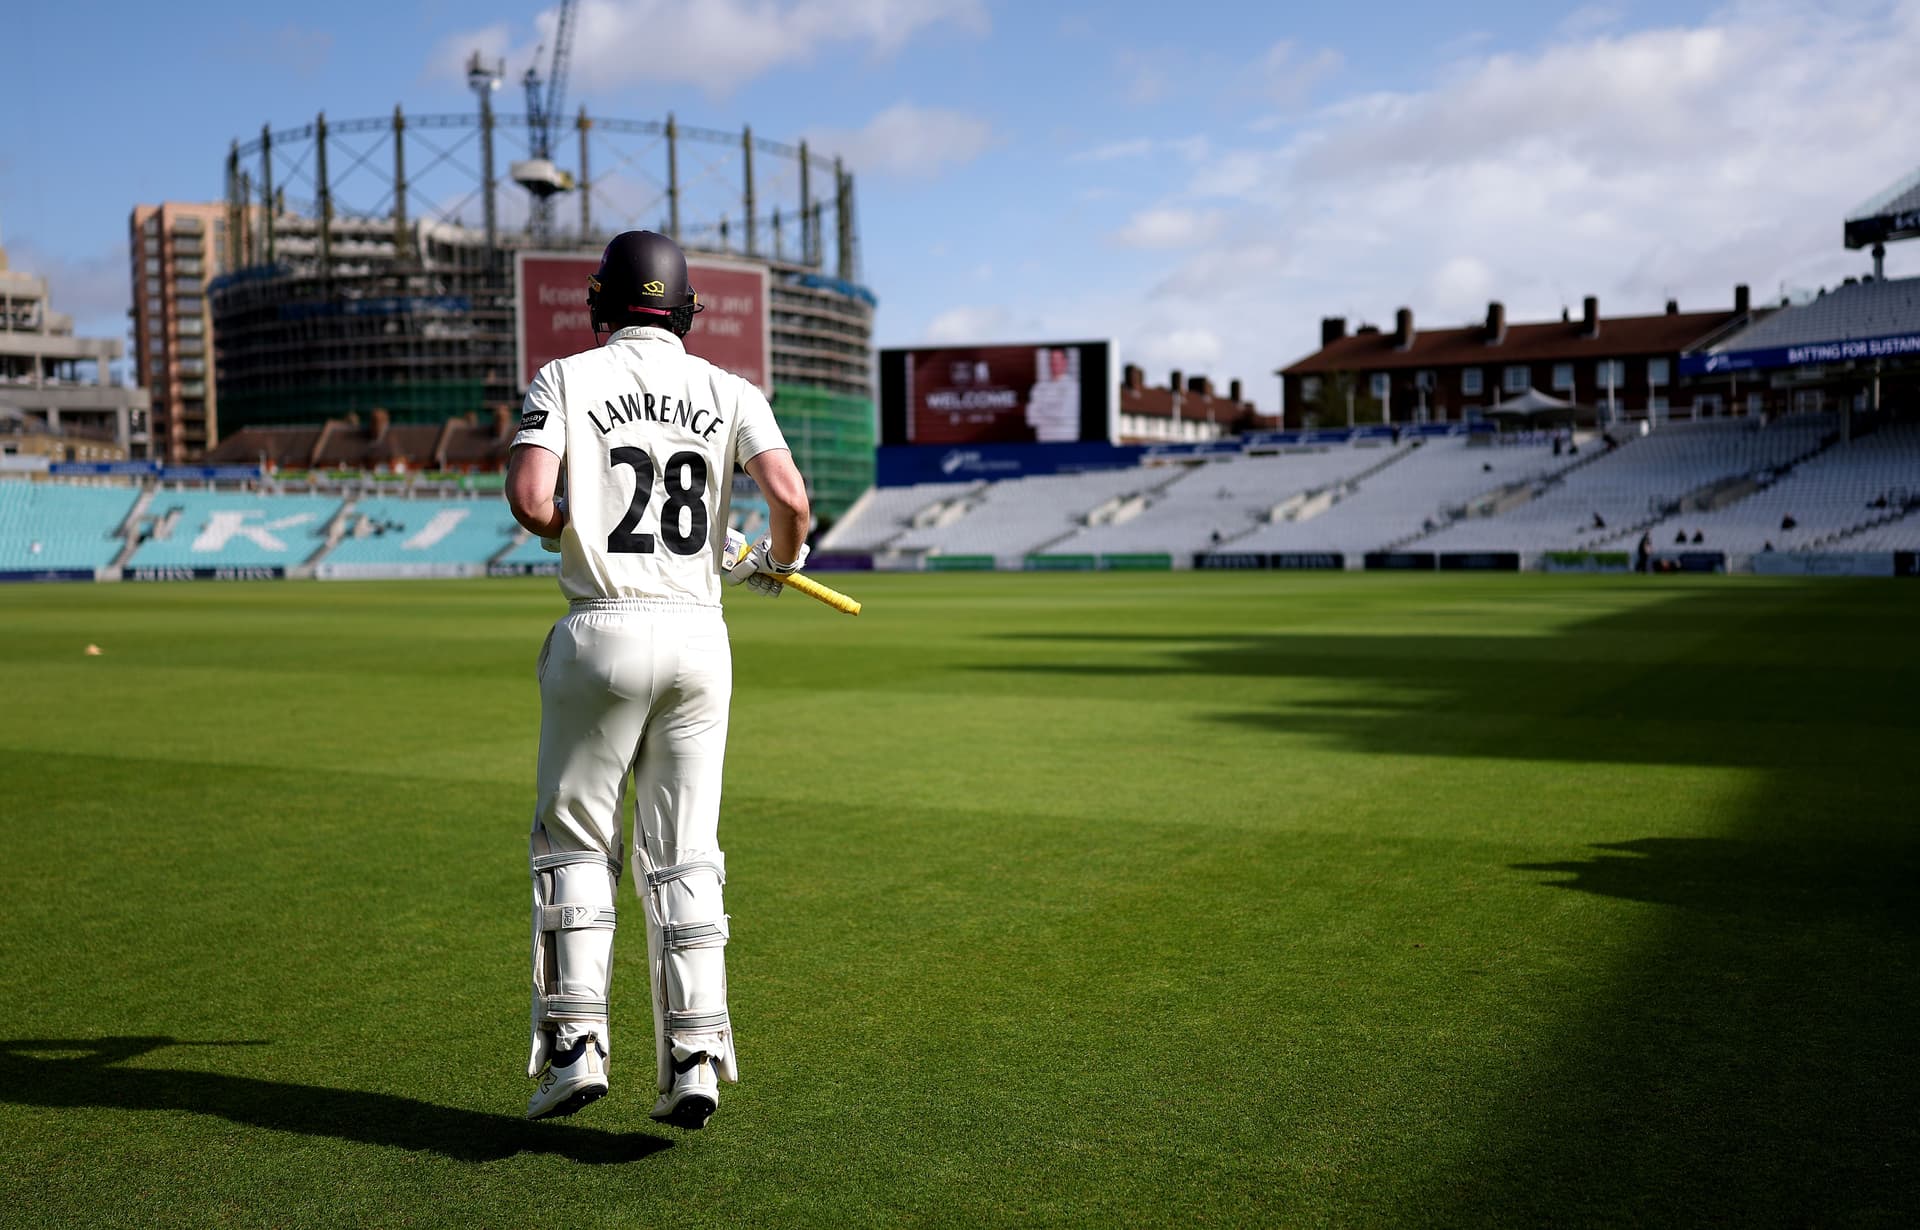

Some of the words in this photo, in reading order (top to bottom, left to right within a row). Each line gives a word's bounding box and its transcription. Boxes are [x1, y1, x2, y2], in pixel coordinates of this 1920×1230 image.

[1788, 344, 1840, 364] BATTING
[1842, 341, 1868, 358] FOR
[587, 392, 724, 443] LAWRENCE
[926, 390, 1017, 410] WELCOME
[607, 446, 708, 556] 28
